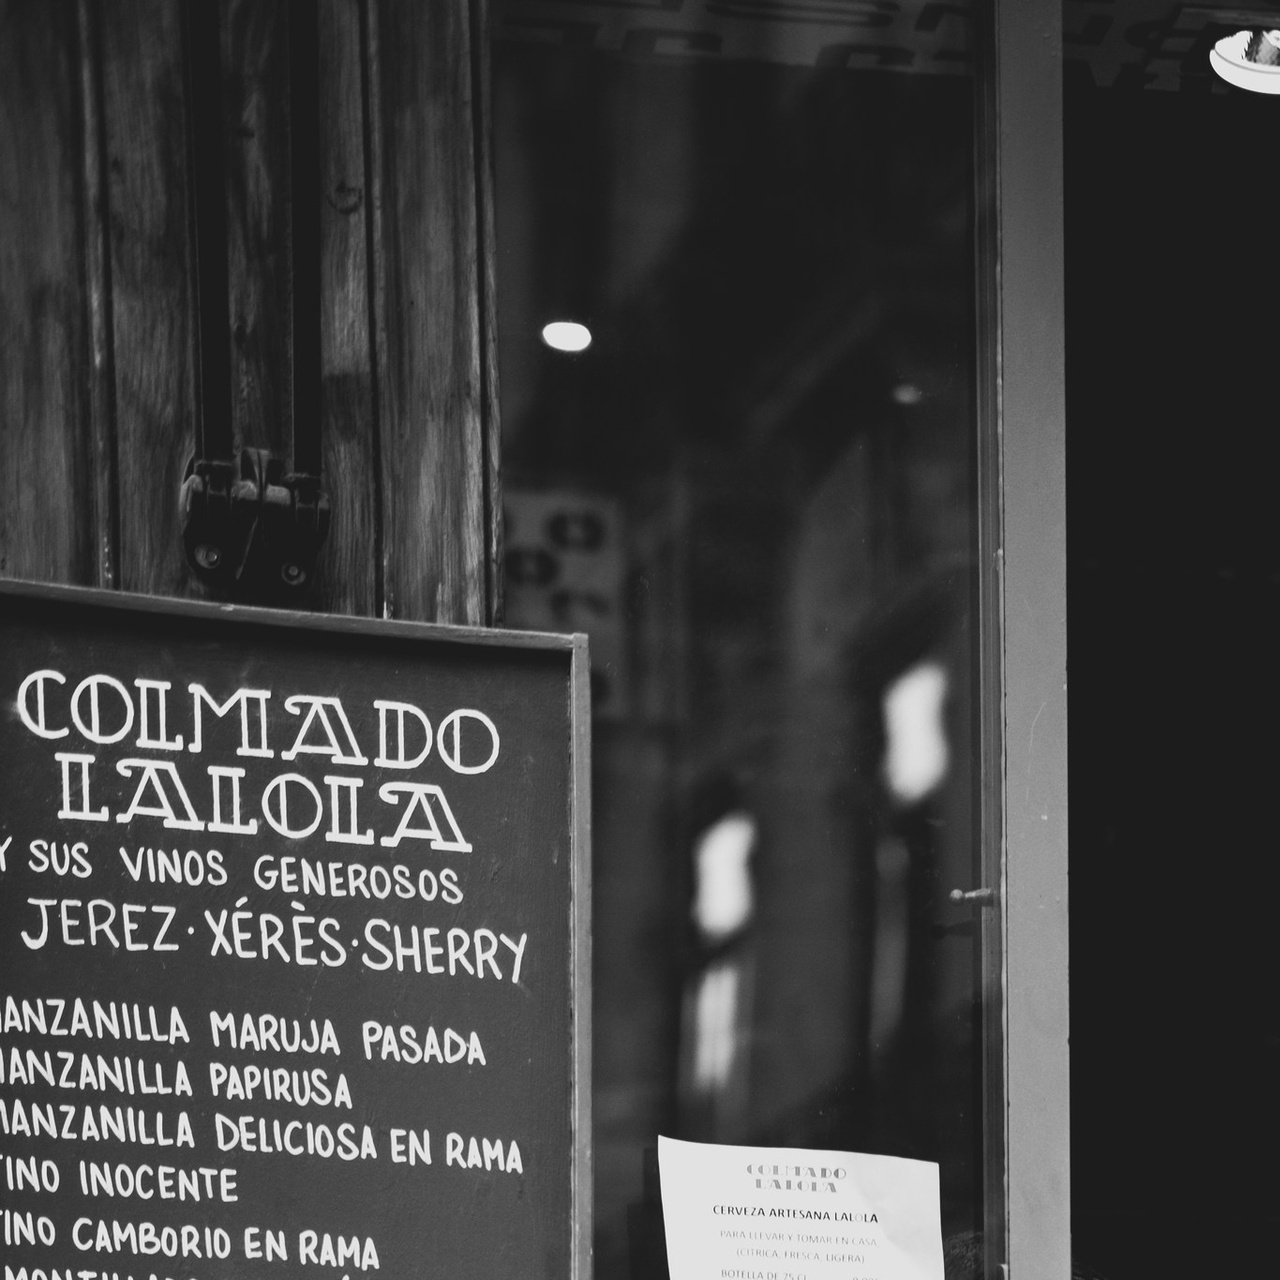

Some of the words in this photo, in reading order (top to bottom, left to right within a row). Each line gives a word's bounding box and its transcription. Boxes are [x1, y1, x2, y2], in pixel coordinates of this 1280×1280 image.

[15, 669, 500, 775] COLMADO
[54, 751, 473, 854] LALOLA
[28, 839, 93, 879] SUS
[118, 846, 228, 886] VINOS
[253, 854, 464, 905] GENEROSOS
[0, 995, 190, 1045] ANZANILLA
[209, 1010, 341, 1056] MARUJA
[362, 1020, 487, 1066] PASADA
[0, 1046, 193, 1097] ANZANILLA
[209, 1062, 353, 1110] PAPIRUSA
[0, 1098, 196, 1149] ANZANILLA
[214, 1112, 378, 1161] DELICIOSA
[389, 1127, 433, 1167] EN
[445, 1131, 524, 1175] RAMA
[0, 1155, 60, 1193] INO
[79, 1160, 239, 1203] INOCENTE
[0, 1209, 56, 1247] INO
[72, 1217, 231, 1259] CAMBORIO
[243, 1226, 288, 1262] EN
[298, 1229, 380, 1272] RAMA
[712, 1204, 766, 1218] CERVEZA
[769, 1208, 831, 1221] ARTESANA
[834, 1211, 879, 1224] LALOLA
